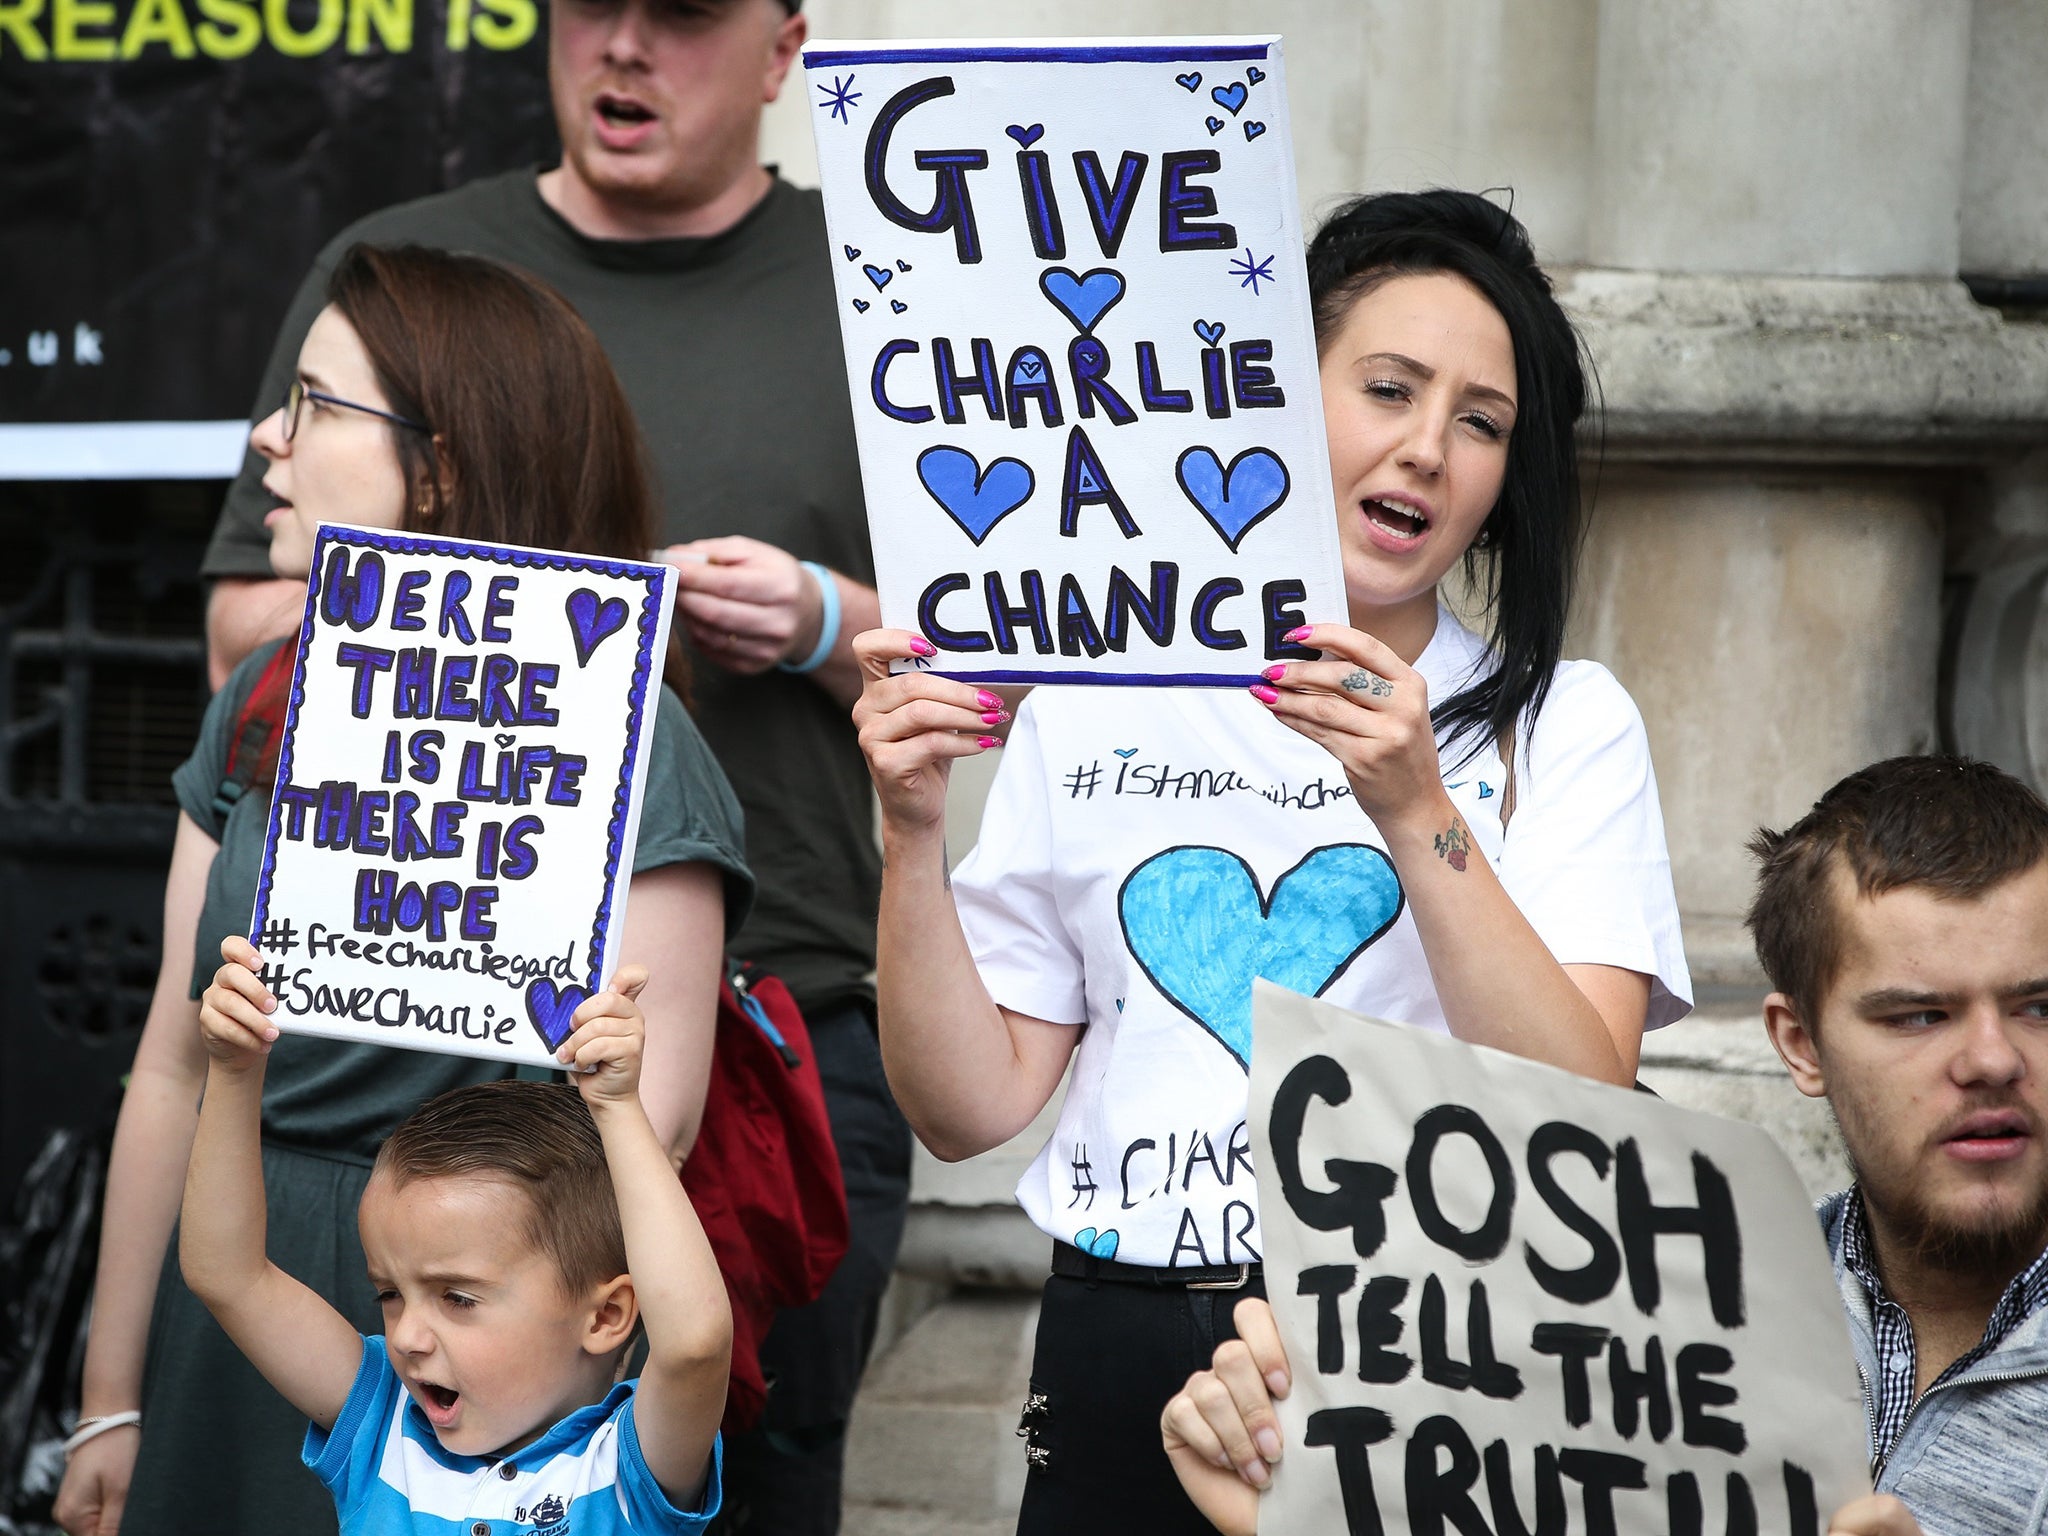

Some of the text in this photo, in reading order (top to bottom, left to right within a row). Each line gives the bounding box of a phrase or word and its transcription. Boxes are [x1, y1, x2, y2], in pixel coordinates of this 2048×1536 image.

[0, 0, 537, 61] REASON IS
[865, 76, 1238, 264] GIVE
[871, 319, 1286, 428] CHARLIE
[1060, 424, 1142, 538] A
[319, 546, 519, 645] WERE
[918, 560, 1322, 661] CHANCE
[336, 641, 560, 727] THERE
[381, 729, 587, 807] IS LIFE
[280, 781, 545, 880] THERE IS
[353, 868, 499, 942] HOPE
[1269, 1054, 1747, 1330] GOSH
[1297, 1265, 1748, 1456] TELL THE
